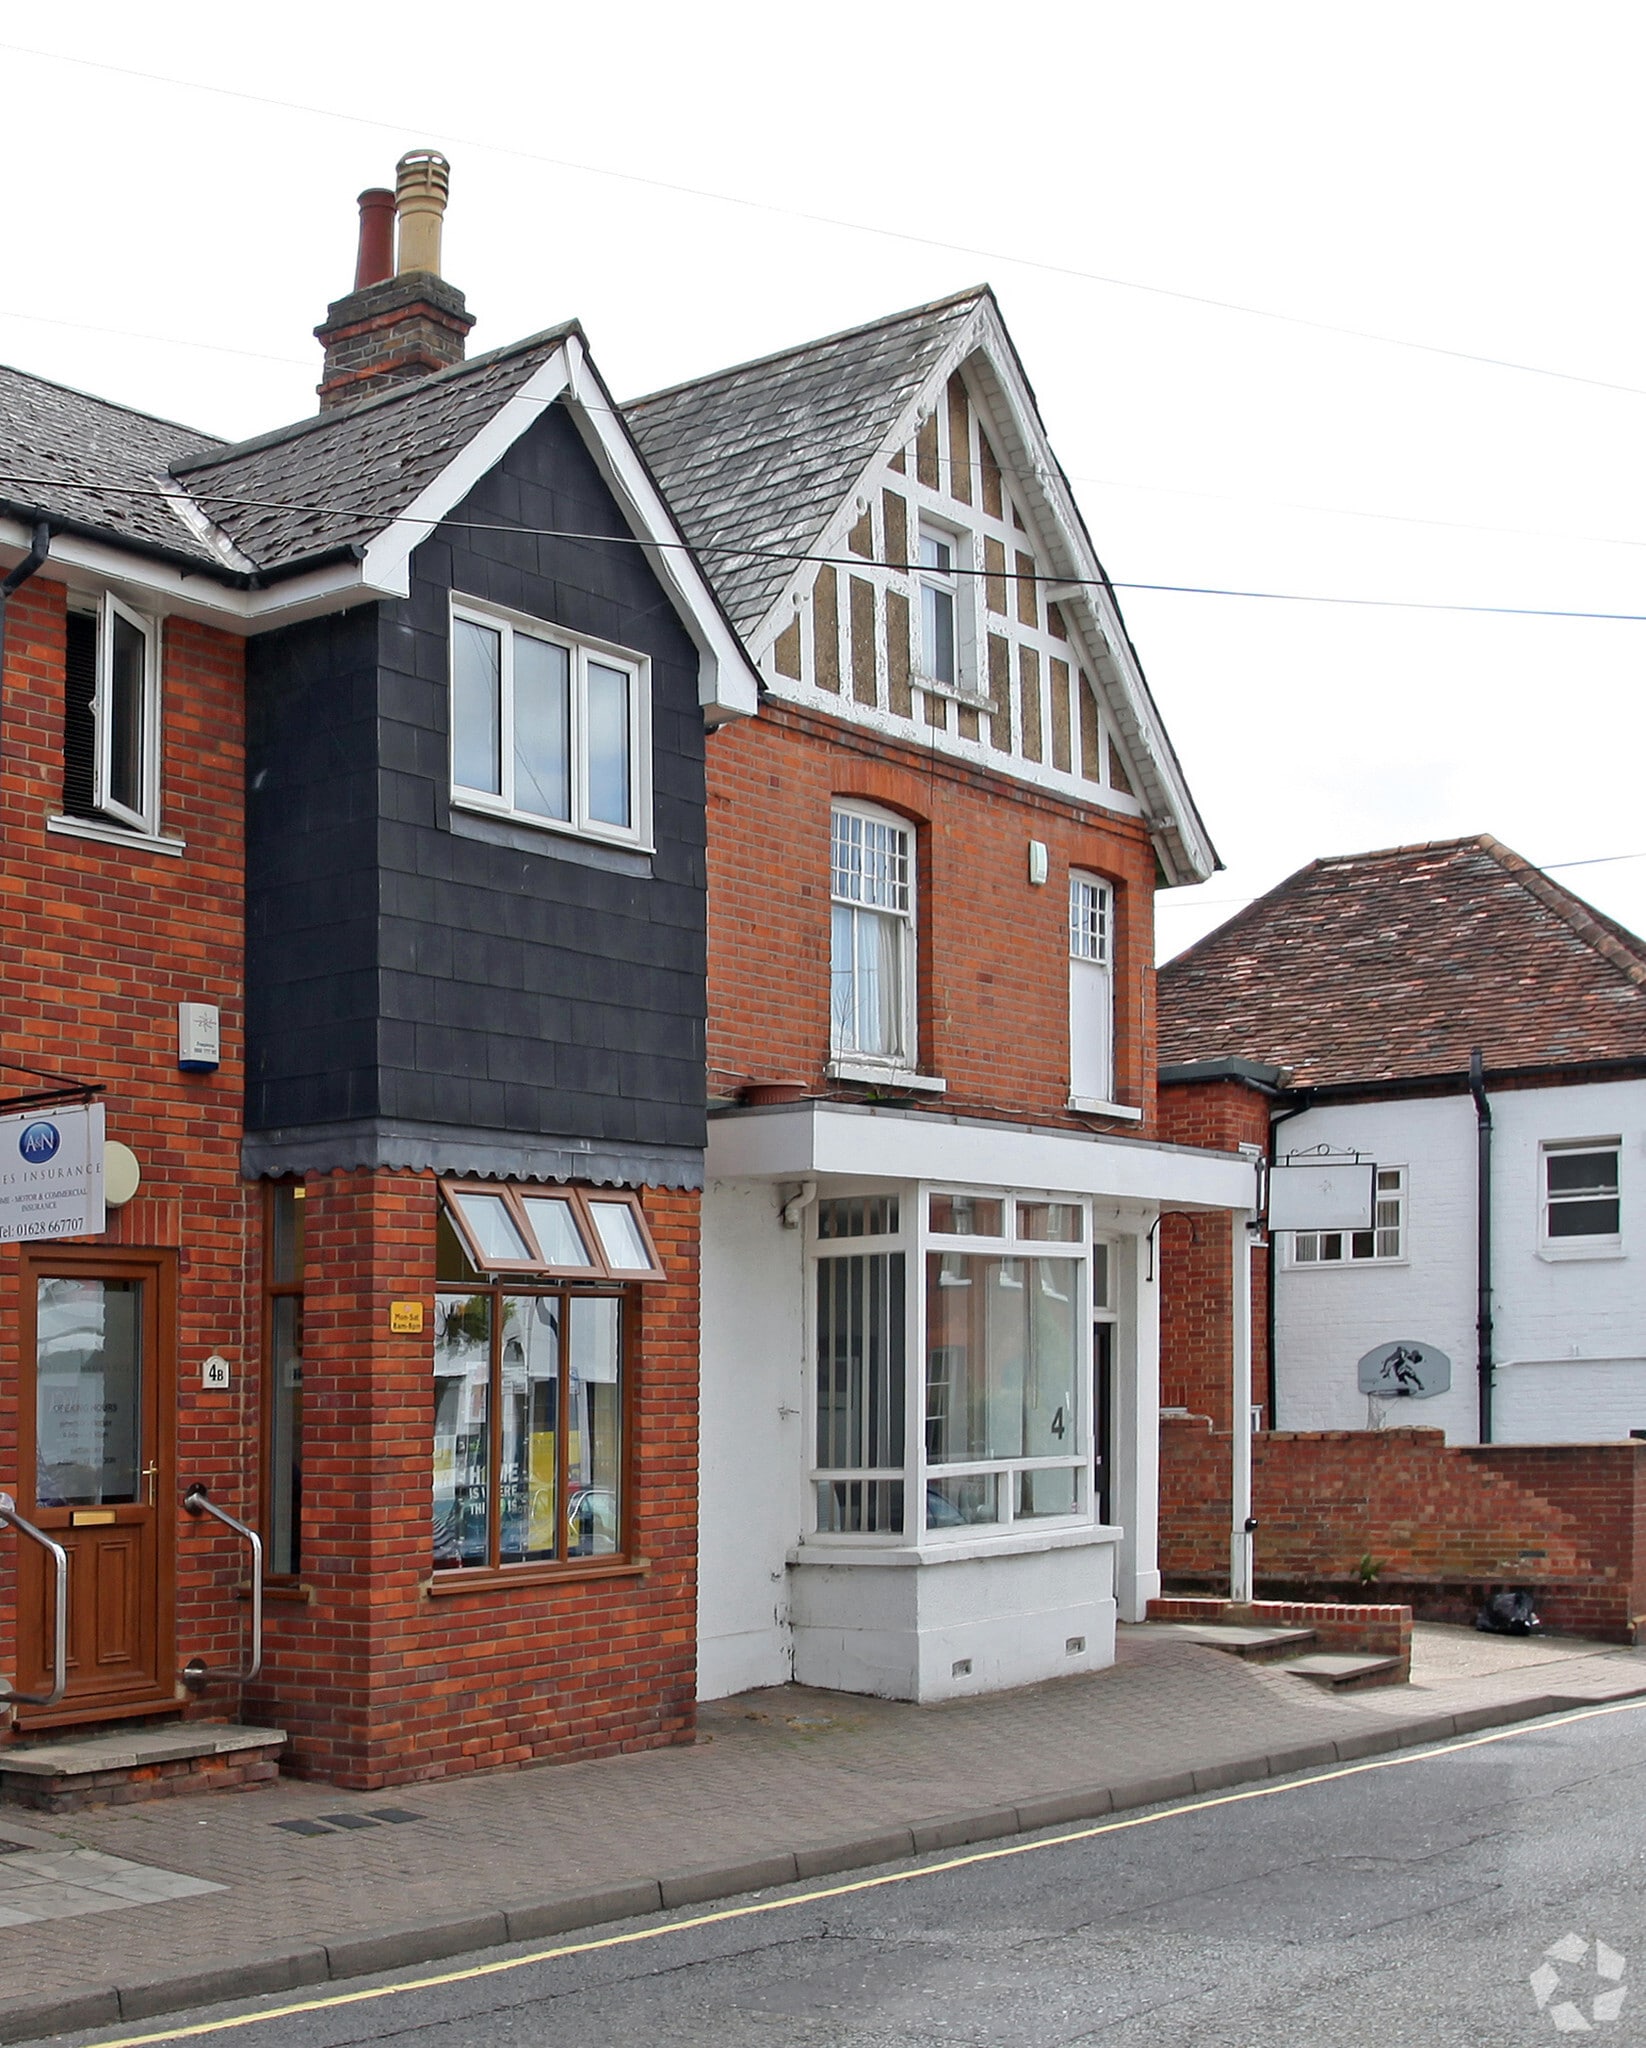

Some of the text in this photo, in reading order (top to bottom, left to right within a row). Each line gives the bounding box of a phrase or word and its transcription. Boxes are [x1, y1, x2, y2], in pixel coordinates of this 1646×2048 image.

[25, 1131, 54, 1153] A&N
[23, 1162, 102, 1183] INSURANCE
[15, 1193, 37, 1202] MOTOR
[38, 1192, 43, 1201] &
[45, 1188, 88, 1200] COMMERCIAL
[21, 1200, 57, 1212] INSURANCE
[16, 1221, 46, 1236] 01628
[48, 1217, 84, 1233] 667707
[208, 1363, 224, 1381] 4B
[1051, 1406, 1065, 1440] 4
[469, 1487, 480, 1500] IS
